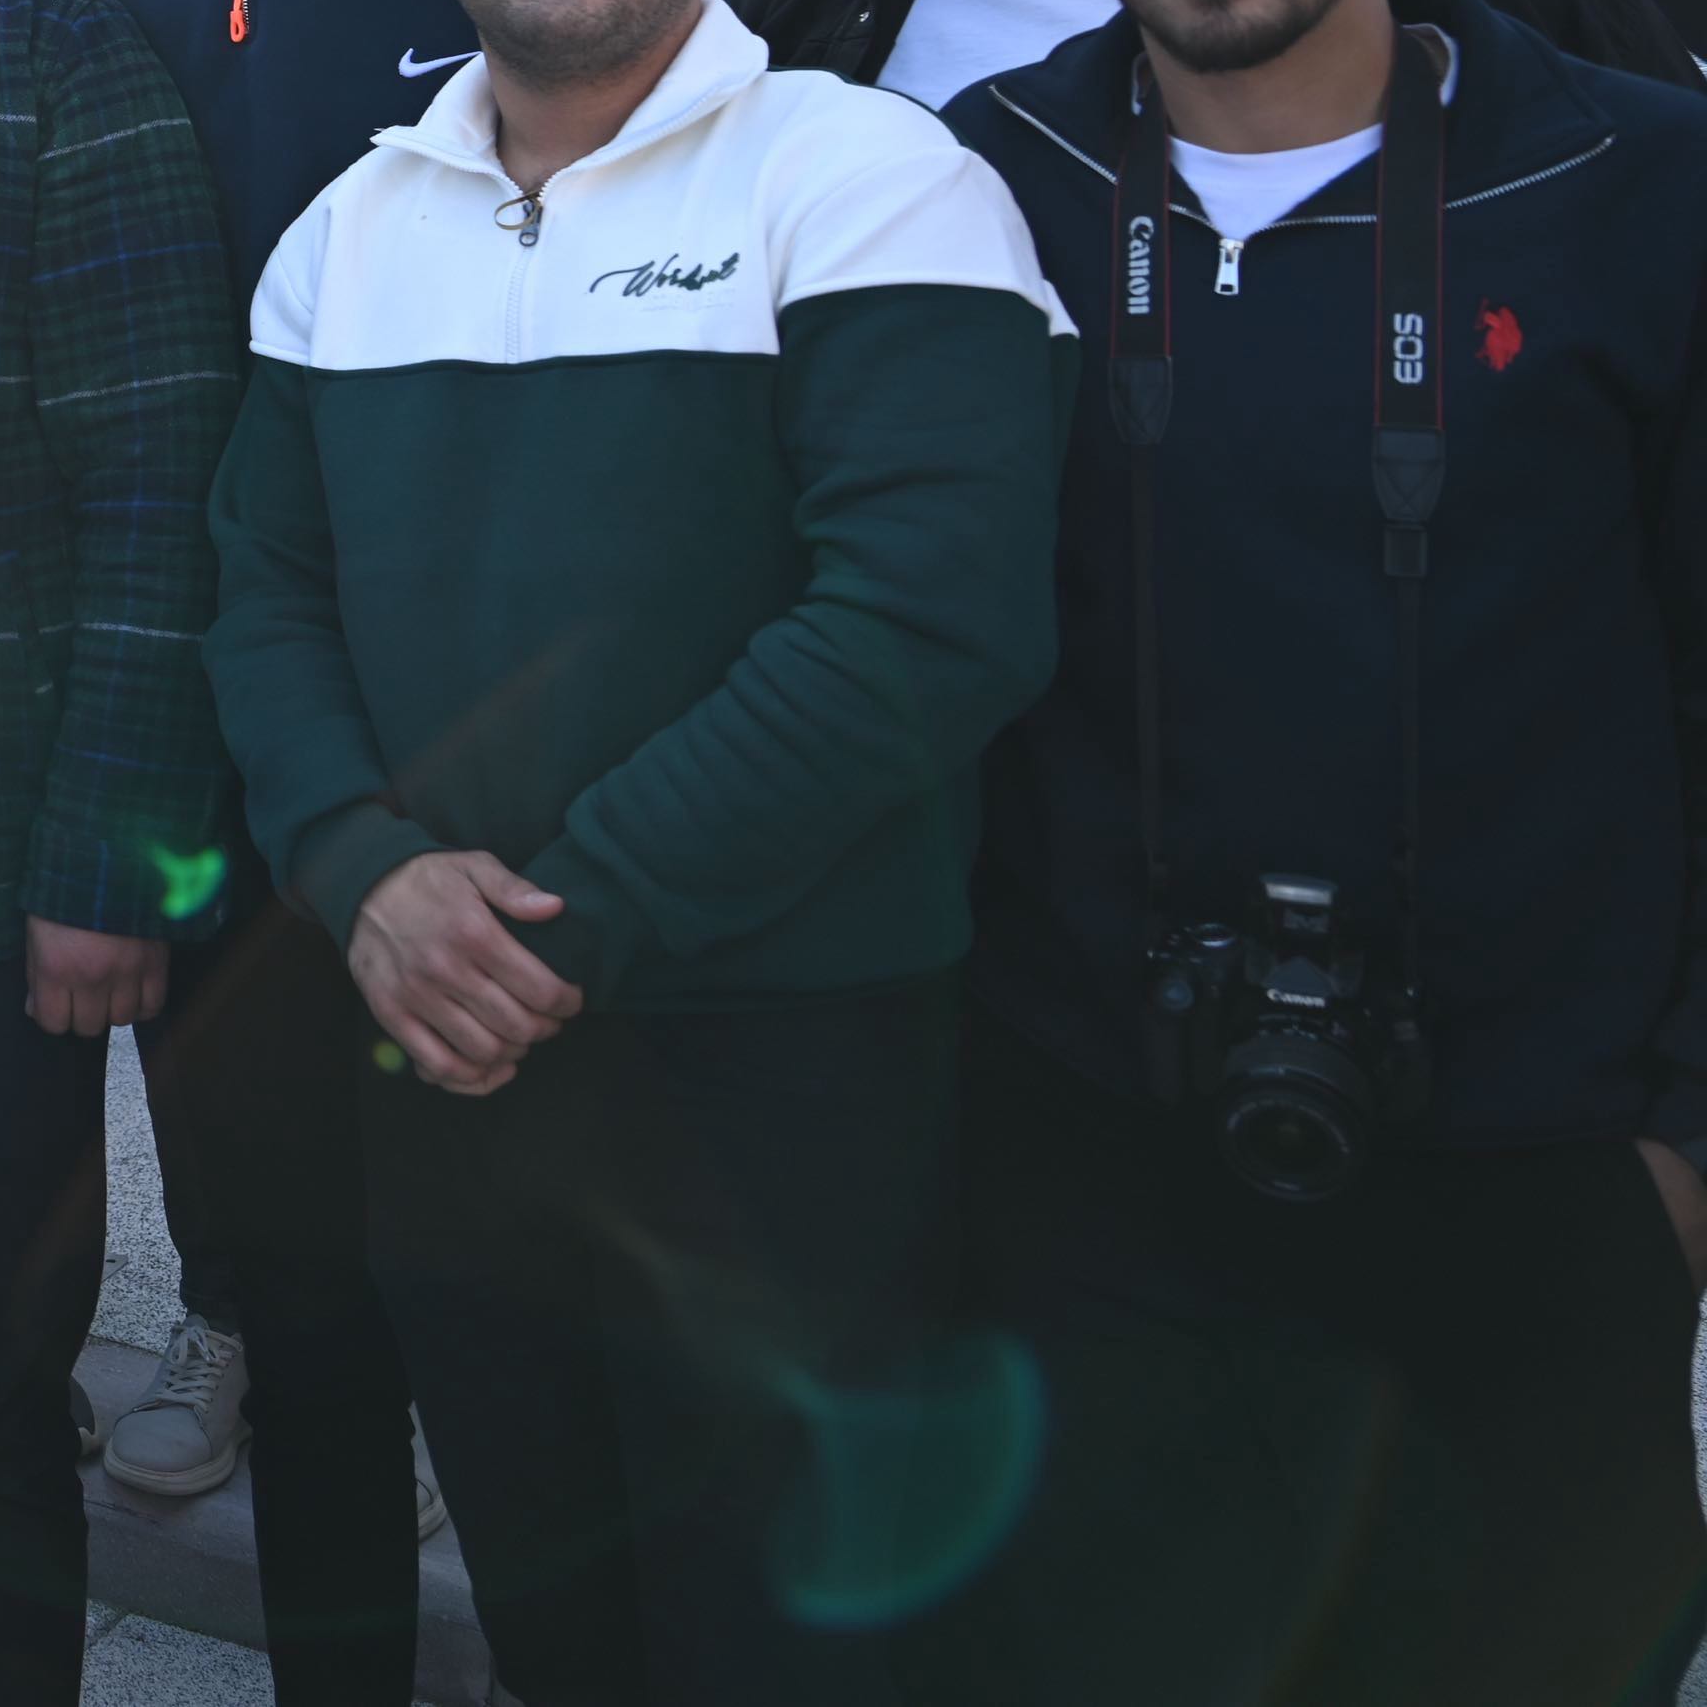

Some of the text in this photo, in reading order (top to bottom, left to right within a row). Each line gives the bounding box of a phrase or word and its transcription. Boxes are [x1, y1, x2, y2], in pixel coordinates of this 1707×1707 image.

[1127, 215, 1155, 315] Canon
[1393, 312, 1424, 384] EOS
[1267, 988, 1326, 1008] Canon
